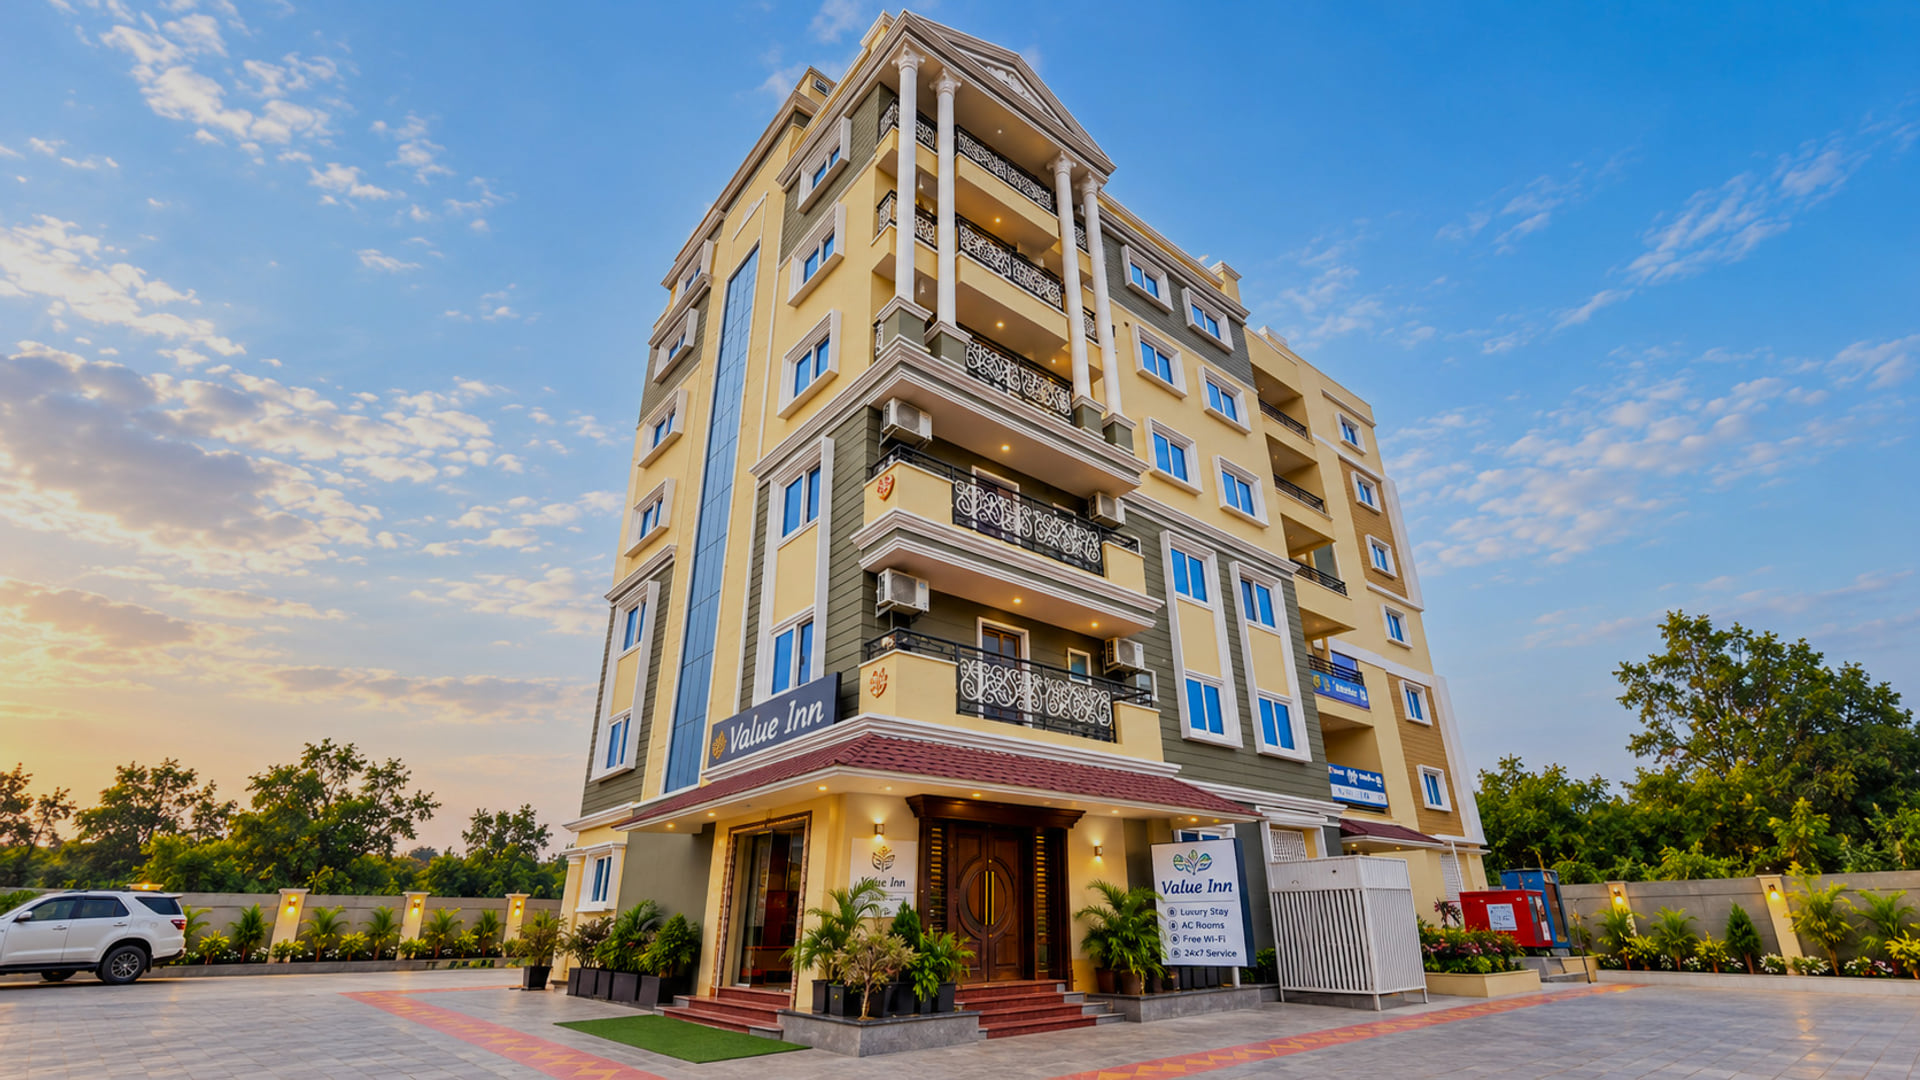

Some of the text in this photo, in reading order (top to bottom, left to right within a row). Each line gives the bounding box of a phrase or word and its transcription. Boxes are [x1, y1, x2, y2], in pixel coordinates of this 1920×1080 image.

[730, 699, 825, 754] Value Inn
[890, 876, 906, 888] Inn
[1161, 879, 1233, 895] Value Inn
[1180, 907, 1229, 918] Luxury Stay
[1181, 921, 1225, 930] AC Rooms
[1182, 934, 1226, 943] Free Wi-Fi
[1205, 948, 1238, 958] Service
